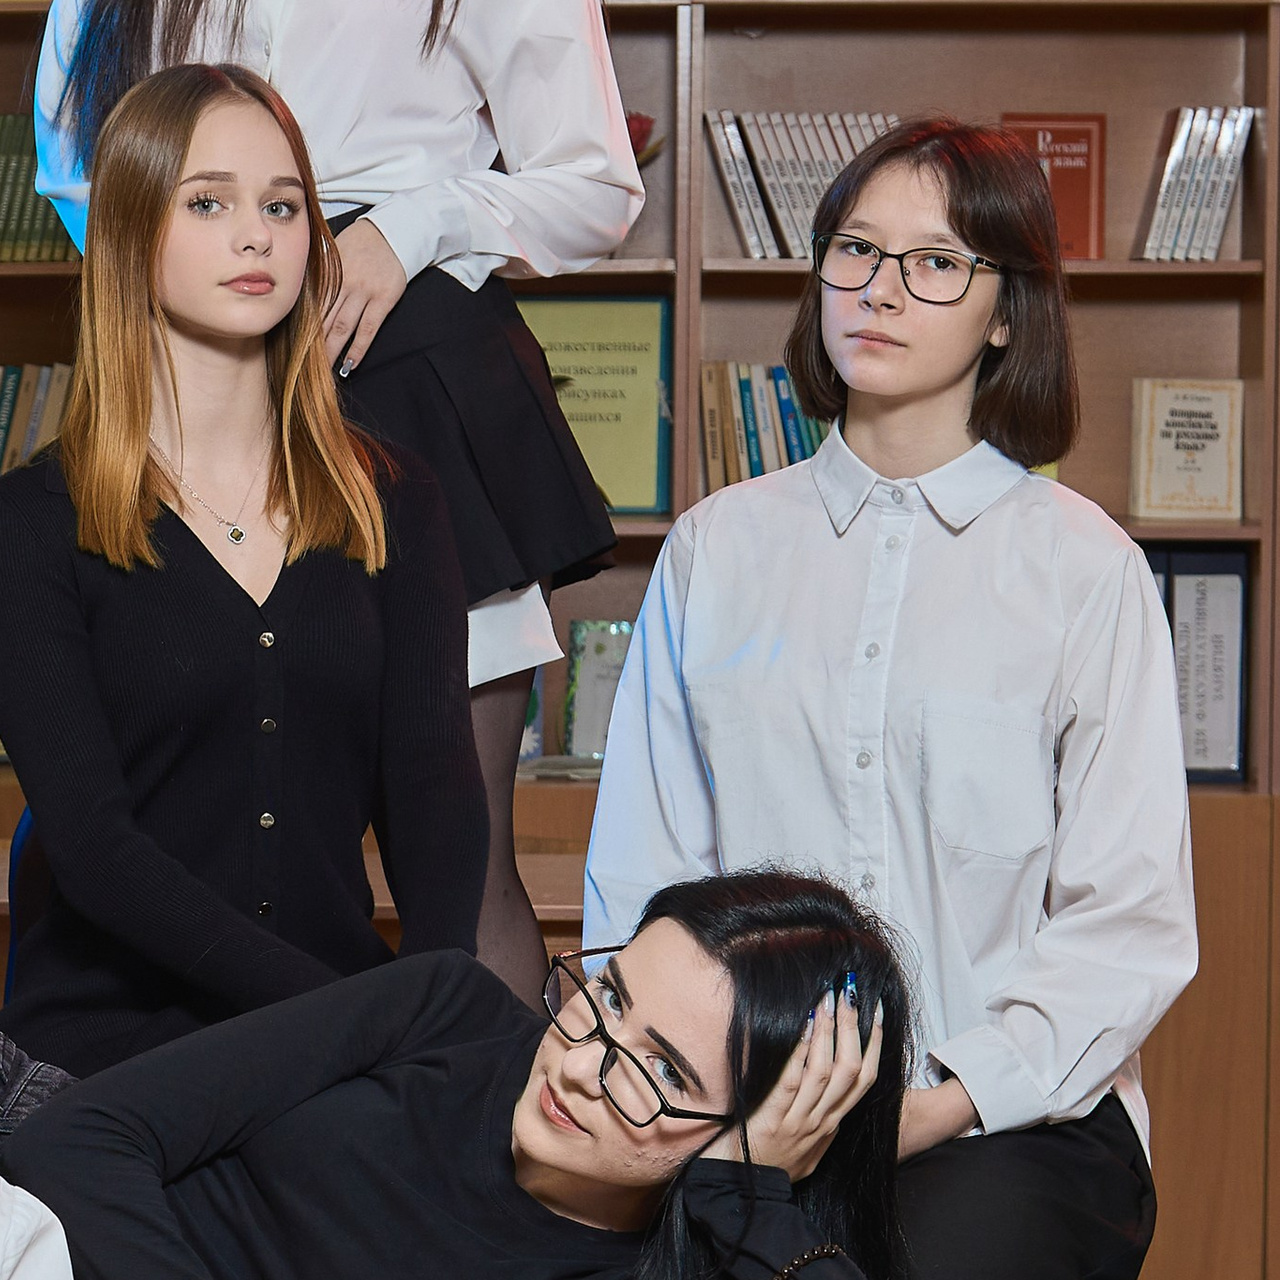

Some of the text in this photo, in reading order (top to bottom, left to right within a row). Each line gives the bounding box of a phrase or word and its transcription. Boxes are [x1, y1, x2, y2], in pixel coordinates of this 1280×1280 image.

[543, 340, 651, 352] дожественные
[551, 364, 638, 376] оизведения
[567, 411, 622, 423] ащихся
